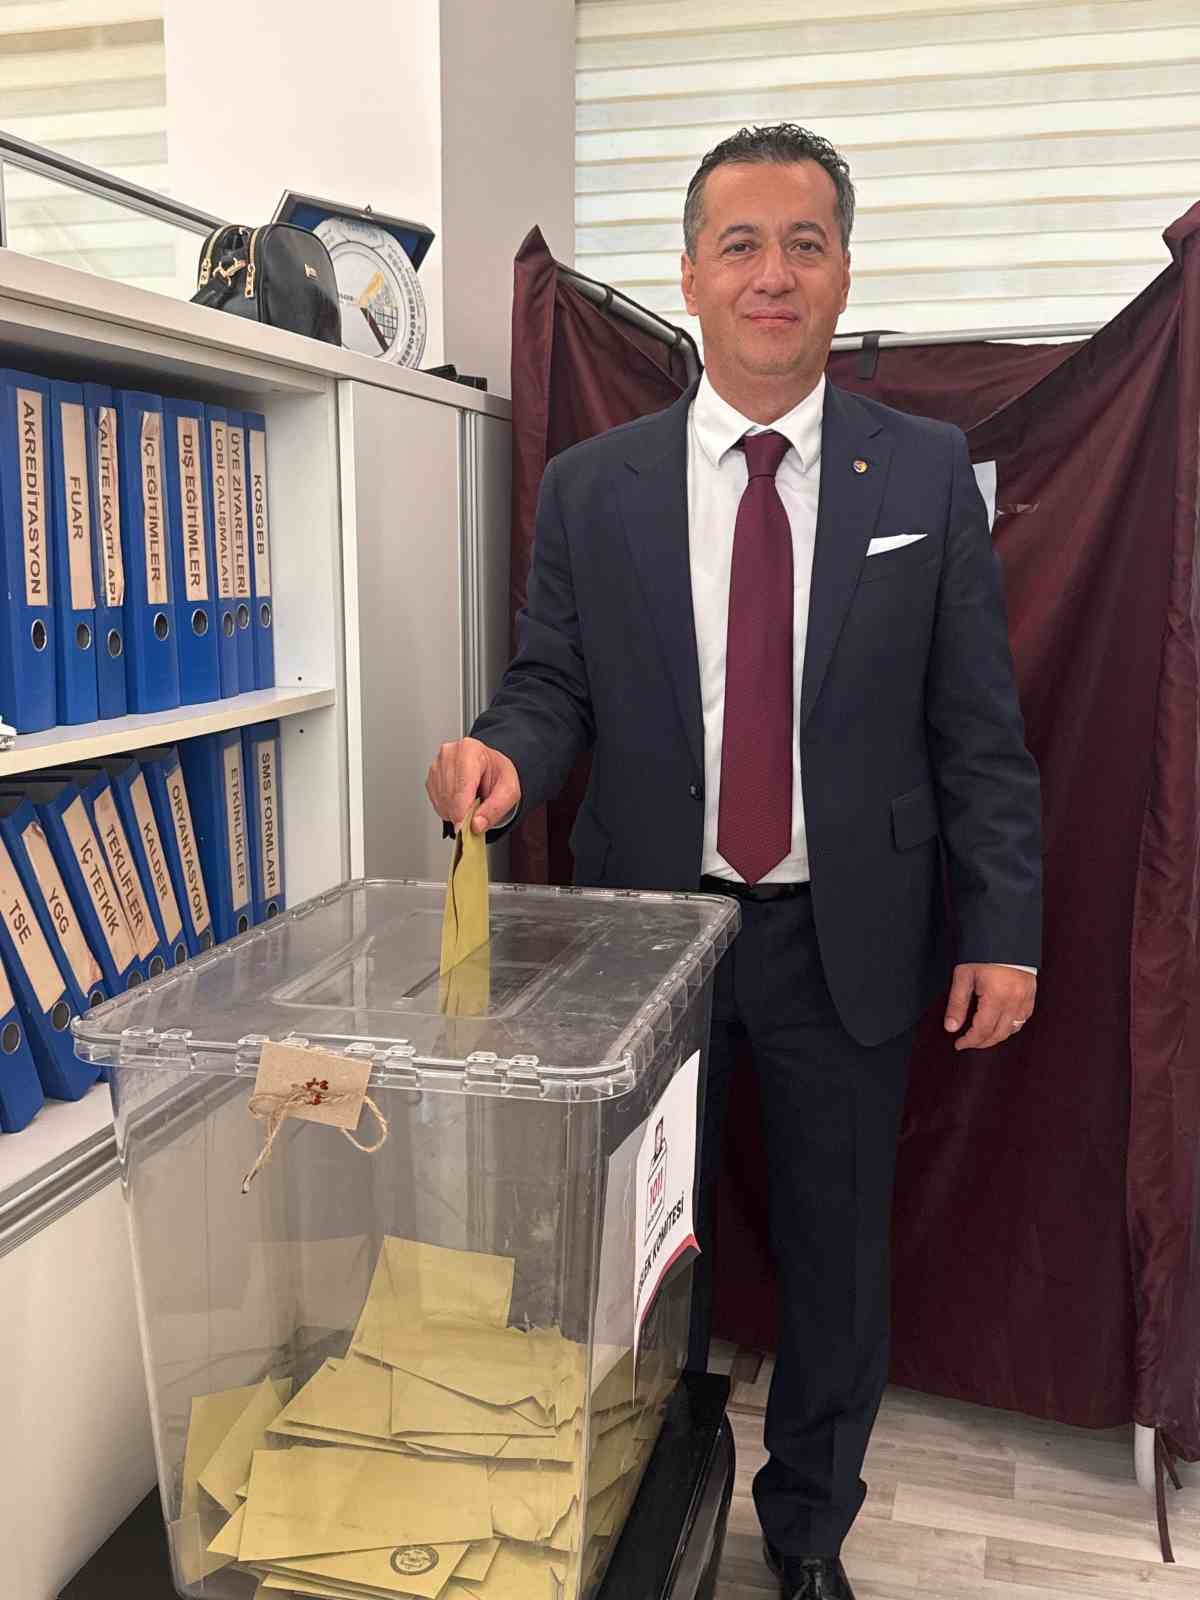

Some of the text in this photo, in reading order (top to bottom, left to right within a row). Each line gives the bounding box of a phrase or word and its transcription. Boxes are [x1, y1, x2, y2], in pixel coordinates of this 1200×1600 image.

[23, 401, 41, 594] AKREDİTASYON
[70, 475, 84, 540] FUAR
[144, 436, 161, 582] İÇ EĞİTİMLER
[182, 434, 201, 587] DIŞ EĞİTİMLER
[216, 475, 229, 594] ÇALIŞMALARI
[231, 433, 248, 594] ÜYE ZİYARETLERİ
[254, 474, 265, 555] KOSGEB
[106, 824, 144, 928] TEKLİFLER
[143, 822, 168, 900] KALDER
[172, 785, 204, 921] ORYANTASYON
[231, 767, 245, 889] ETKİNLİKLER
[262, 752, 276, 889] SMS FORMLARI
[9, 898, 32, 945] TSE
[48, 888, 70, 935] YGG
[80, 838, 120, 936] İÇ TETKİK
[652, 1189, 685, 1263] KOMİTESİ
